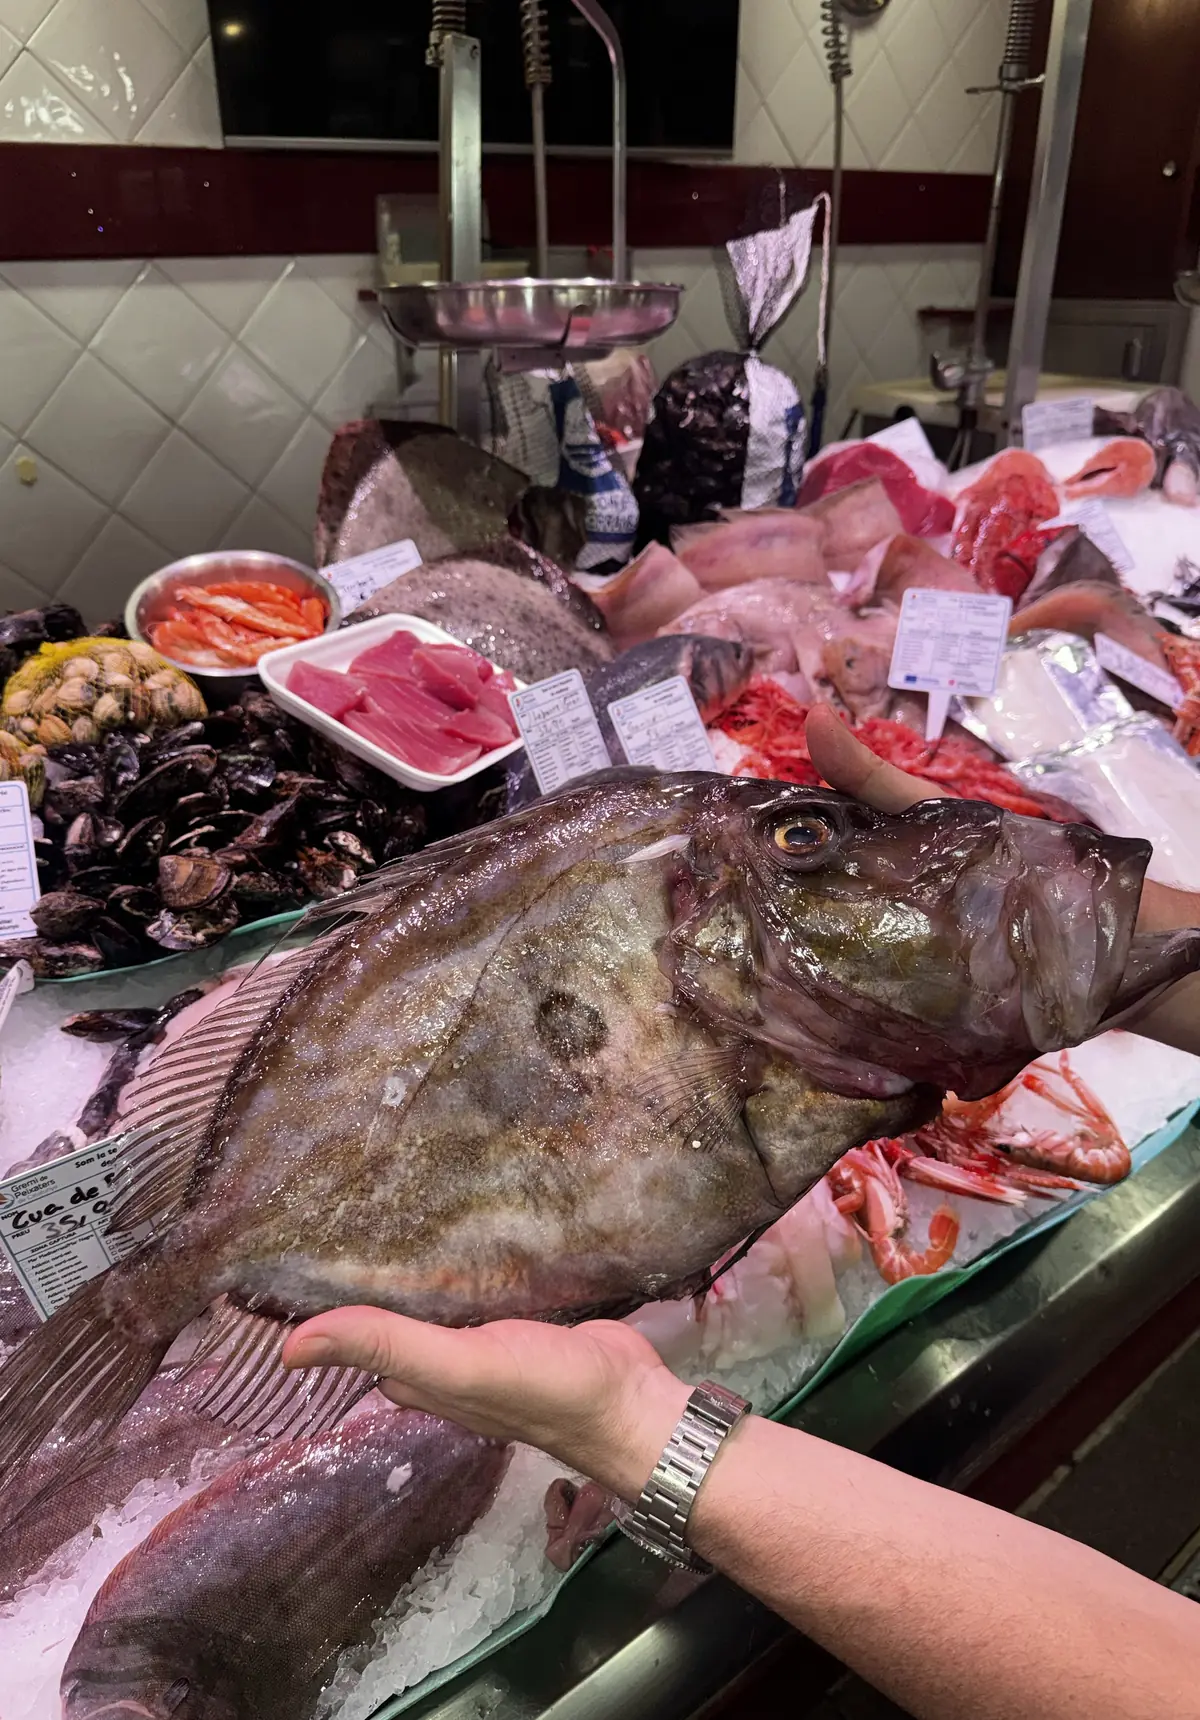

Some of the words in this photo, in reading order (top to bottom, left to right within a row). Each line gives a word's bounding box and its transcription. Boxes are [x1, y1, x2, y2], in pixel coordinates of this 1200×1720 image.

[75, 1157, 95, 1168] Som
[11, 1177, 38, 1192] Gremi
[14, 1179, 55, 1199] Peixaters
[1, 1210, 19, 1220] NOM
[12, 1203, 65, 1230] Cua
[70, 1187, 99, 1204] de
[12, 1229, 30, 1239] PREU
[31, 1244, 48, 1253] ZONA
[49, 1232, 76, 1245] CAPTURA
